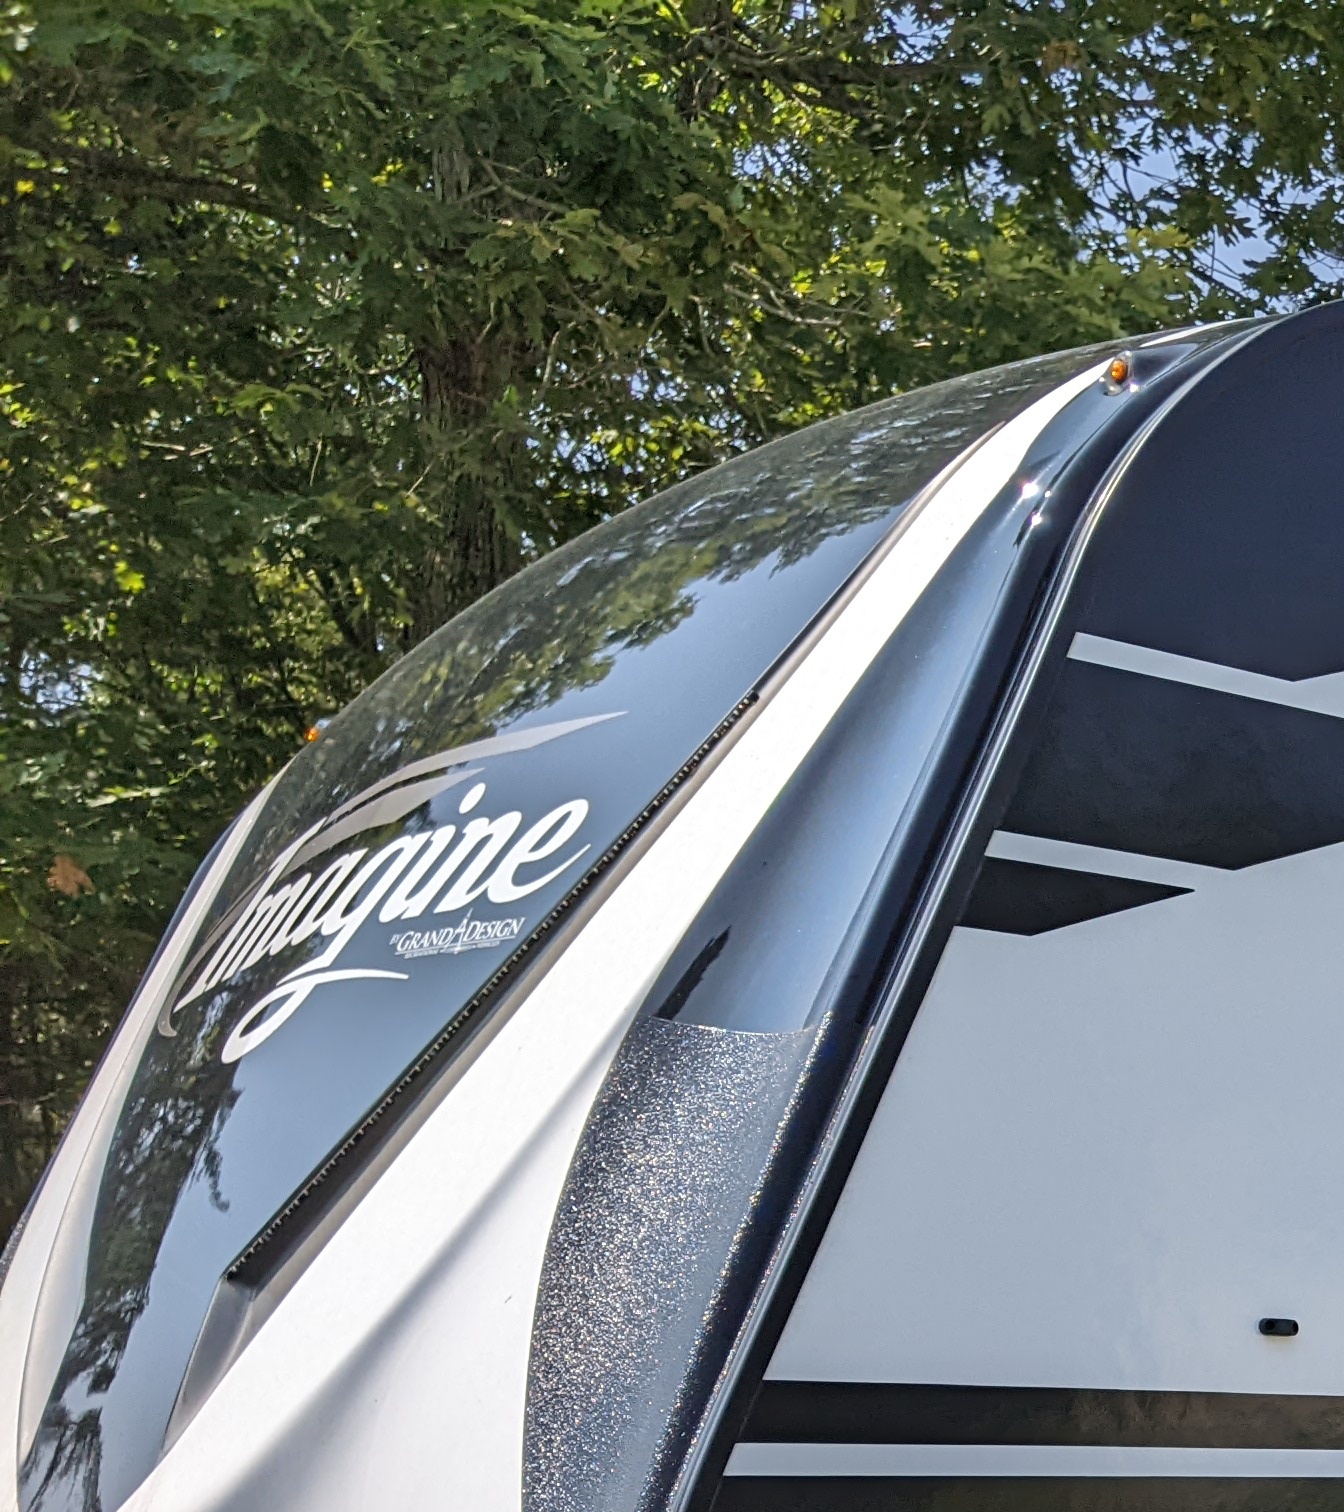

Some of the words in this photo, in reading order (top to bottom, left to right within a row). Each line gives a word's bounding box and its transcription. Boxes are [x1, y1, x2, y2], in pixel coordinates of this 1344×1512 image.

[173, 782, 591, 1064] Imagine
[396, 926, 457, 952] GRAND
[464, 916, 526, 942] DESIGN
